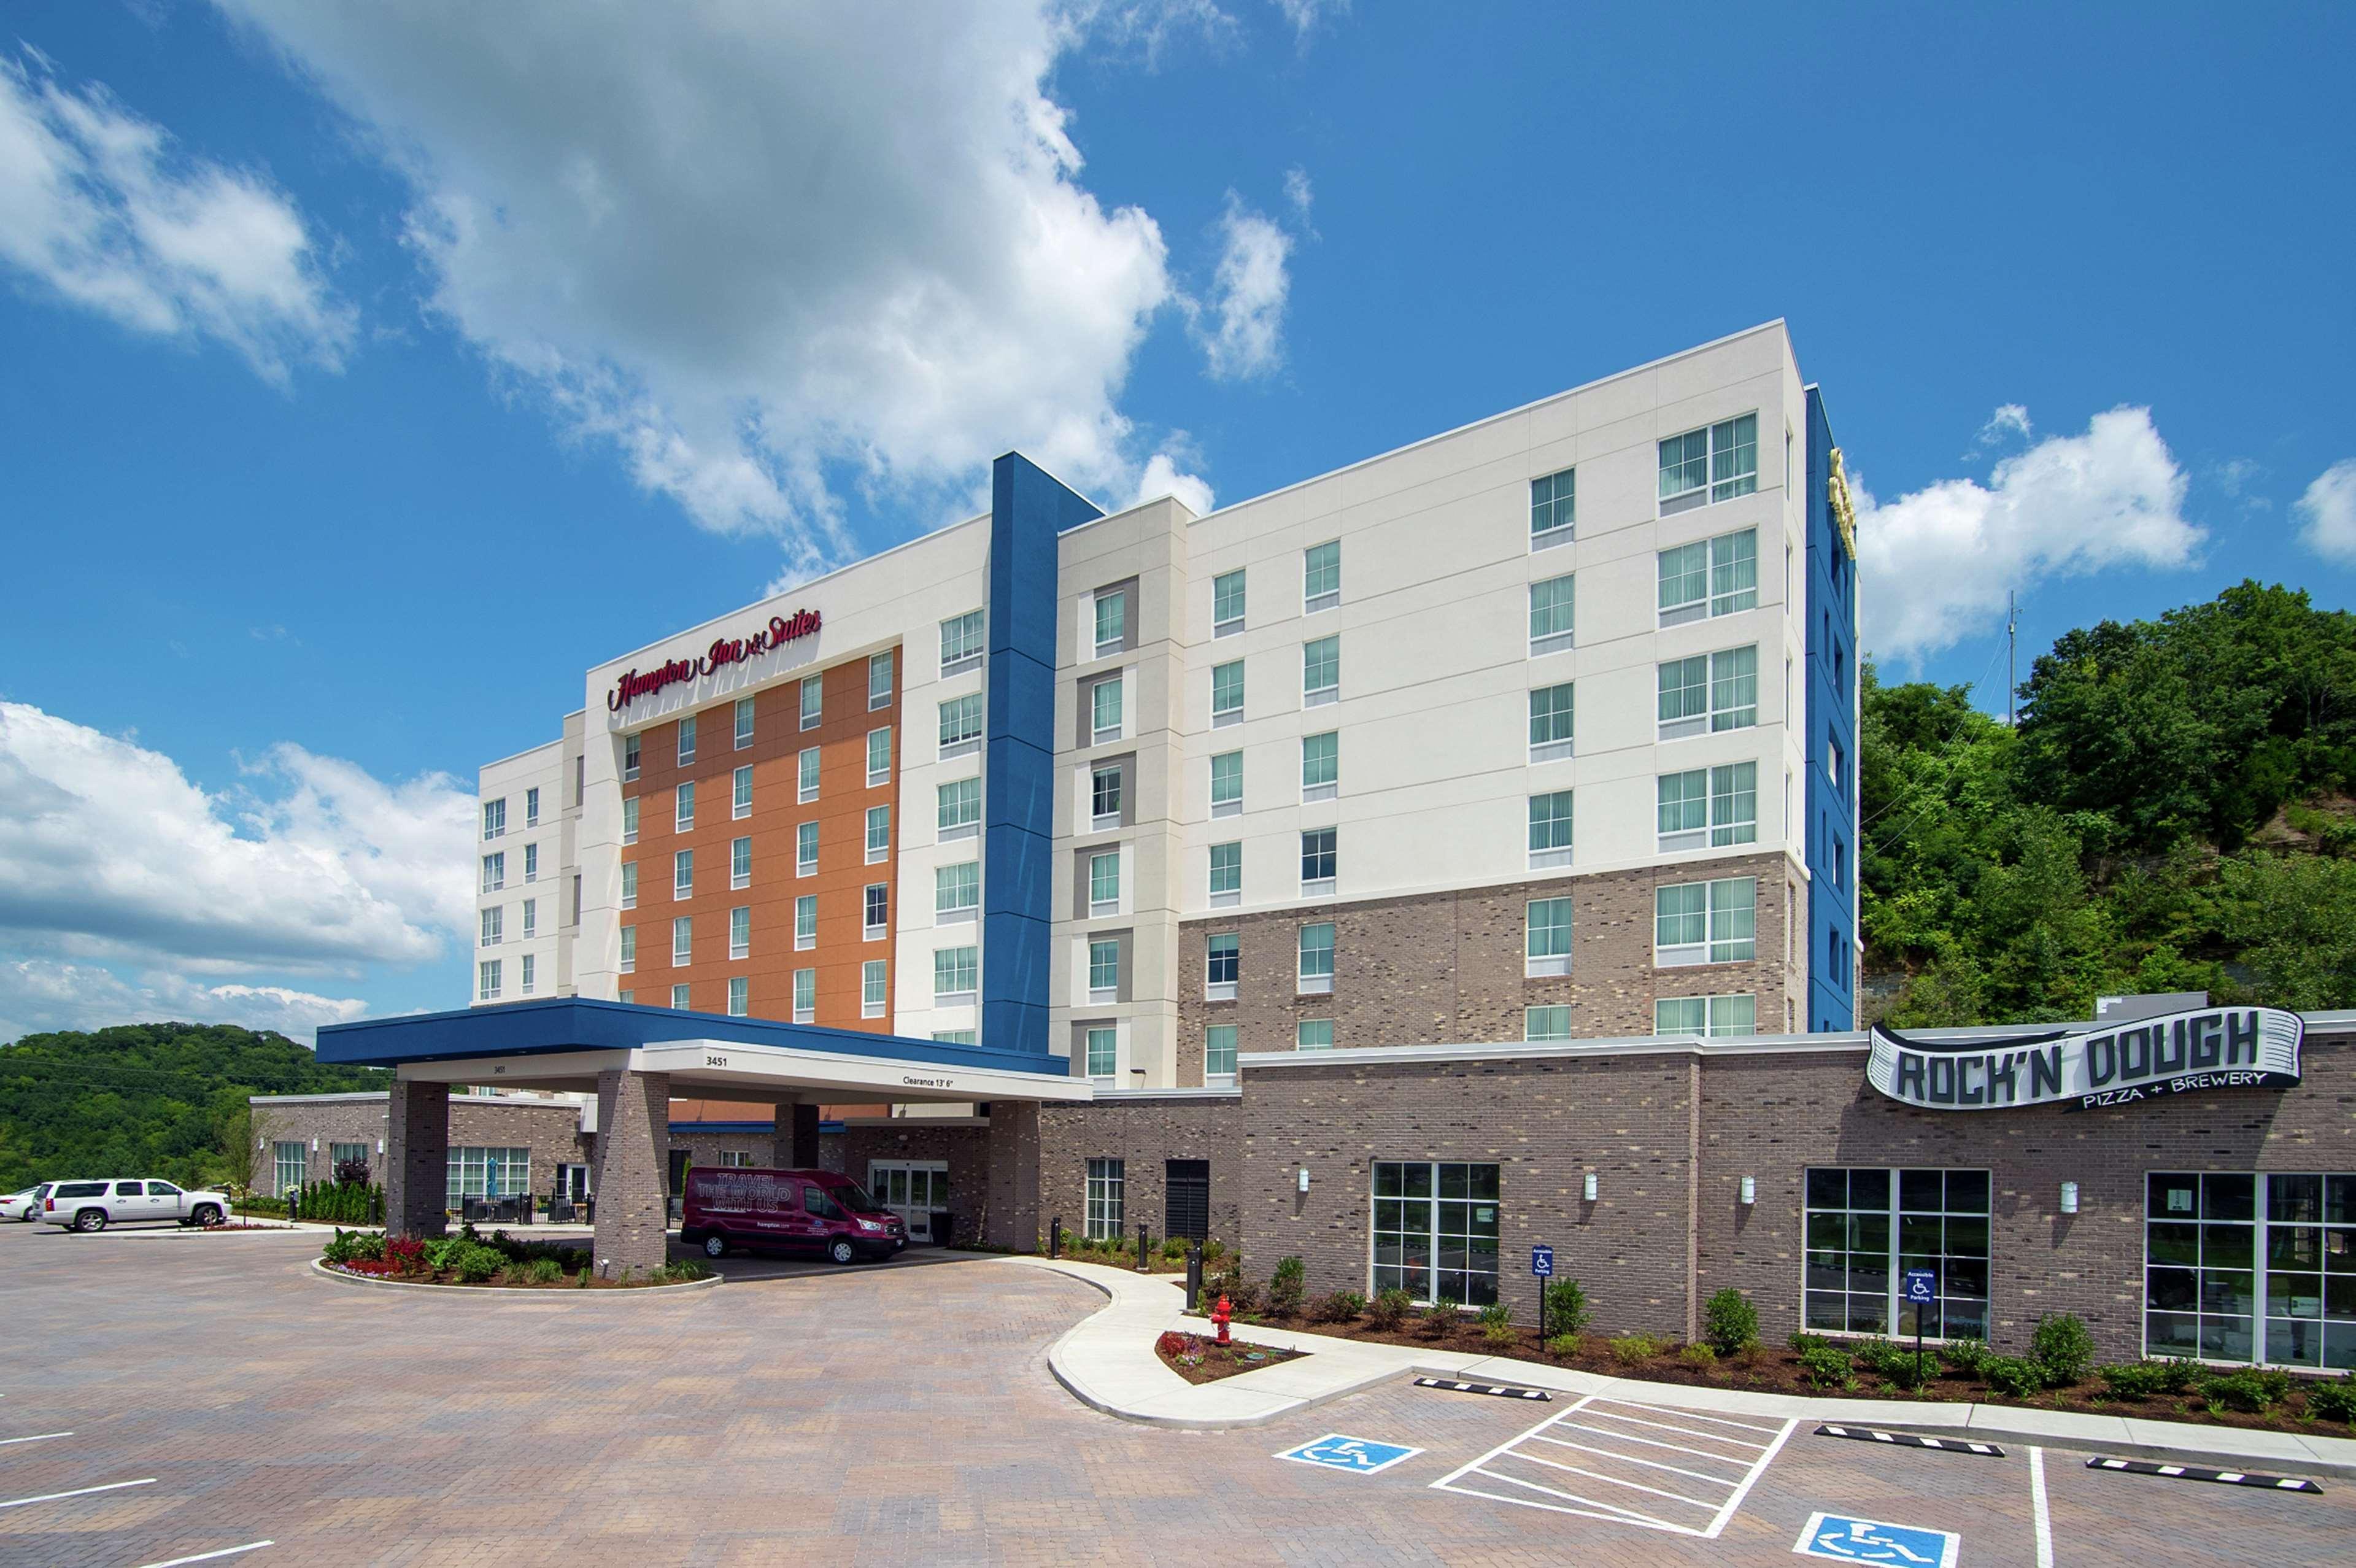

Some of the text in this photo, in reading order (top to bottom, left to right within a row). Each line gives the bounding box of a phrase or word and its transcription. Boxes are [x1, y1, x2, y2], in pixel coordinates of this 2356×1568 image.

[607, 608, 822, 712] Hampton Inn & Suites
[706, 1056, 727, 1067] 3451
[1898, 1011, 2259, 1104] ROCK'N DOUGH
[903, 1076, 934, 1086] Clearance
[2082, 1088, 2144, 1109] PIZZA
[2170, 1072, 2268, 1092] BREWERY
[717, 1173, 777, 1189] TRAVEL
[697, 1183, 791, 1202] THE WORLD
[712, 1197, 778, 1213] WITH US
